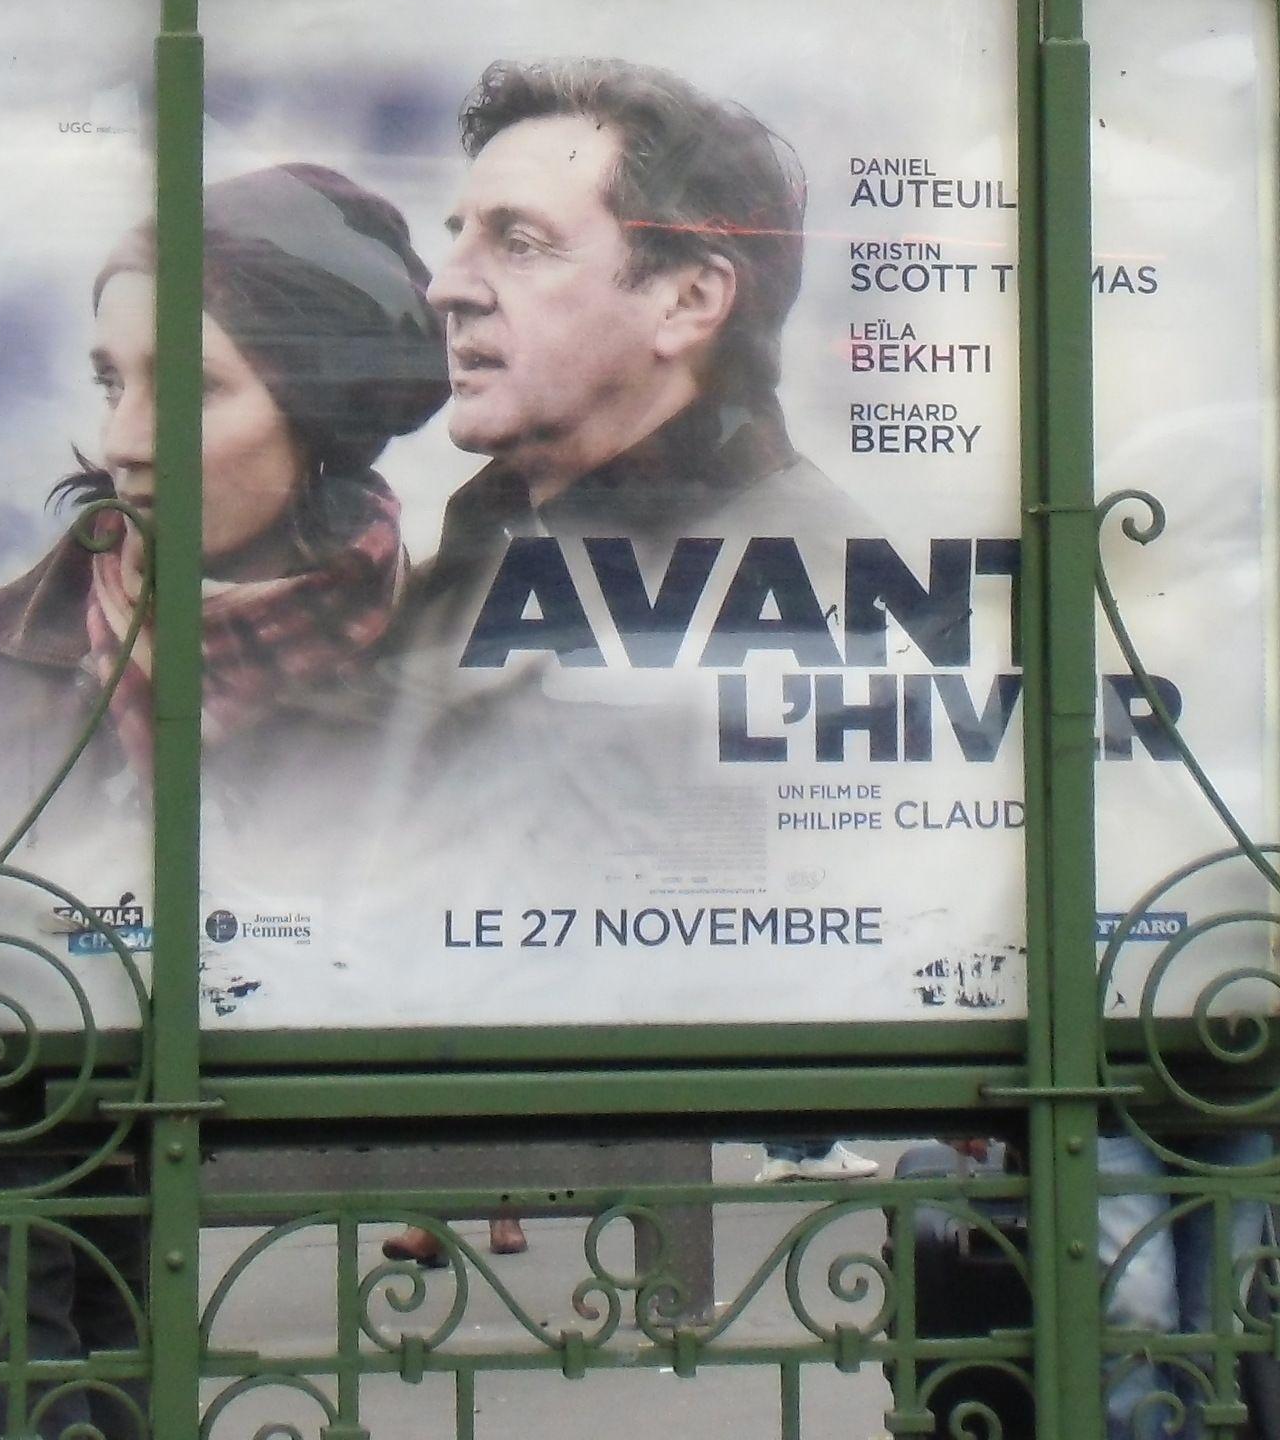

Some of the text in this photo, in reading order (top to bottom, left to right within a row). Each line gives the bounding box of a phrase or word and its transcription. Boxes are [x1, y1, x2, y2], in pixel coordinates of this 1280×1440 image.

[58, 121, 93, 134] UGC
[850, 158, 937, 177] DANIEL
[850, 178, 1018, 209] AUTEUIL
[850, 242, 941, 261] KRISTIN
[850, 263, 978, 294] SCOTT
[850, 319, 916, 342] LEÏLA
[851, 344, 992, 373] BEKHTI
[850, 403, 958, 421] RICHARD
[850, 424, 982, 454] BERRY
[718, 673, 1187, 762] L'HIVR
[778, 785, 882, 800] UN FILM DE
[777, 812, 882, 831] PHILIPPE
[254, 913, 292, 924] Journal
[444, 906, 884, 948] LE 27 NOVEMBRE
[241, 922, 312, 938] Femmes
